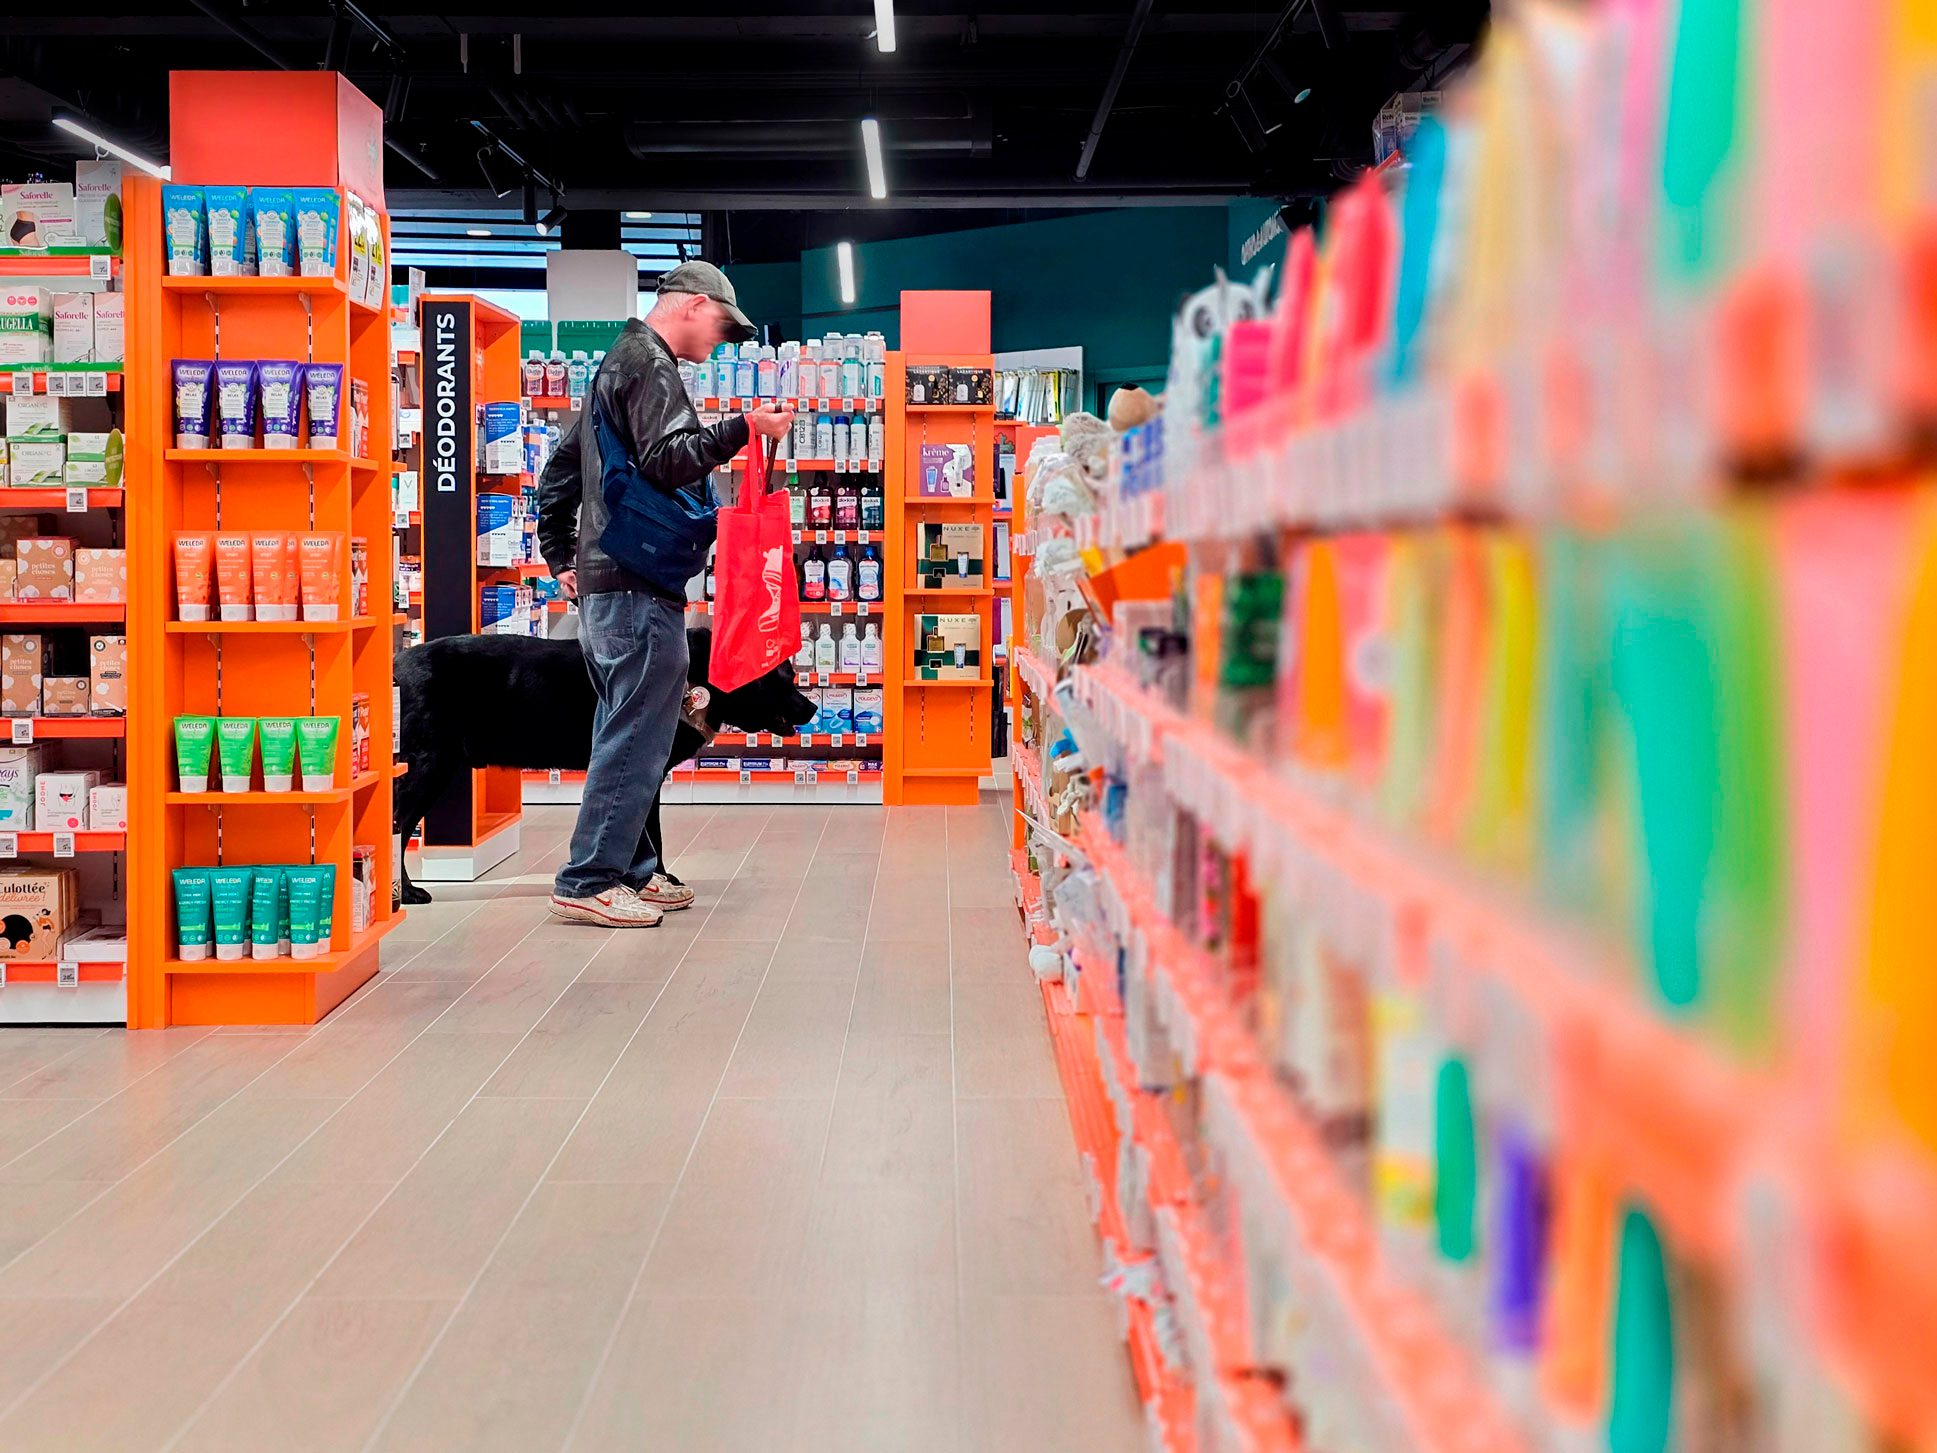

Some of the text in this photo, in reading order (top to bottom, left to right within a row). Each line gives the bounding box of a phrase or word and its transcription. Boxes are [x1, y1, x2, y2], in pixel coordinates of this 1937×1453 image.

[78, 184, 112, 192] Saforelle
[56, 311, 88, 320] Saforelle
[0, 317, 34, 330] UGELLA
[432, 313, 456, 492] DÉODORANTS
[922, 448, 949, 457] krème
[0, 768, 19, 782] ays
